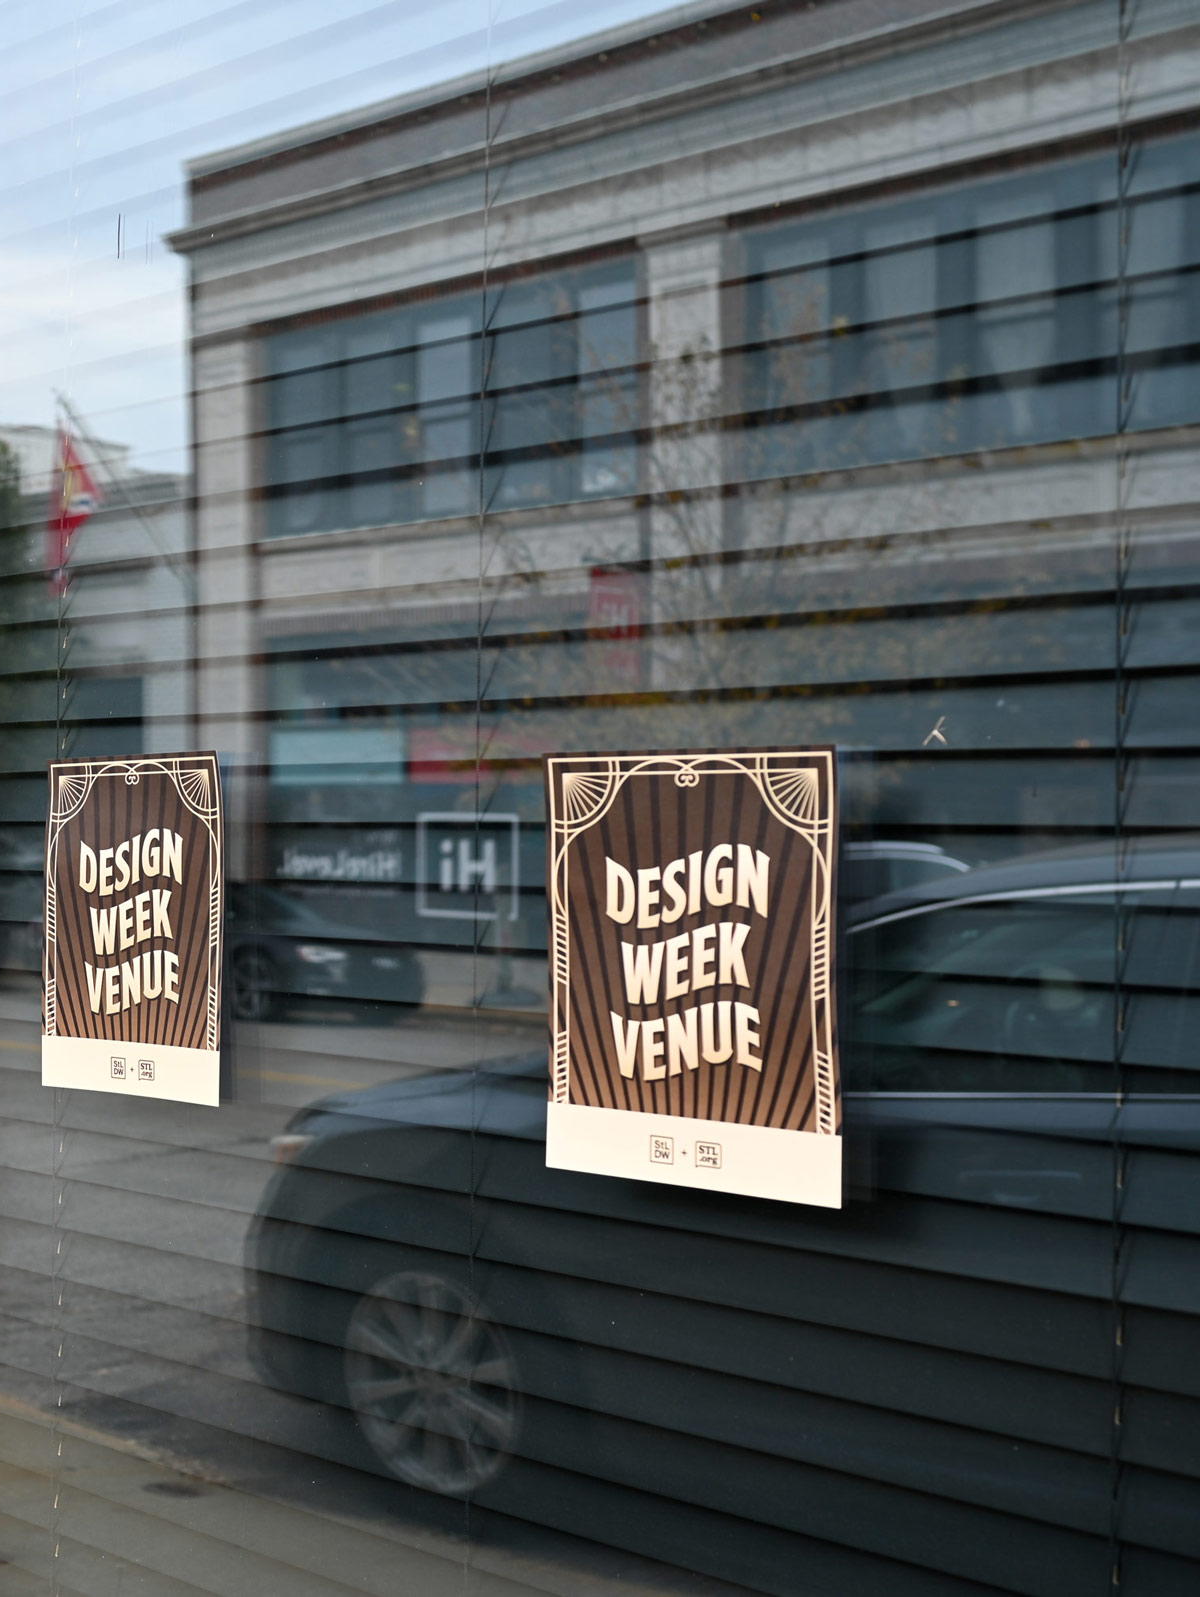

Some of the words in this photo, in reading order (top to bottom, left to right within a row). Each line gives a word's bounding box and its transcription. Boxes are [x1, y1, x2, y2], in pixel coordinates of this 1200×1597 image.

[78, 827, 184, 897] DESIGN
[604, 842, 772, 930] DESIGN
[88, 888, 174, 957] WEEK
[83, 949, 180, 1017] VENUE
[619, 921, 752, 1006] WEEK
[609, 1000, 764, 1082] VENUE
[654, 1149, 670, 1159] DW
[699, 1145, 718, 1155] STL
